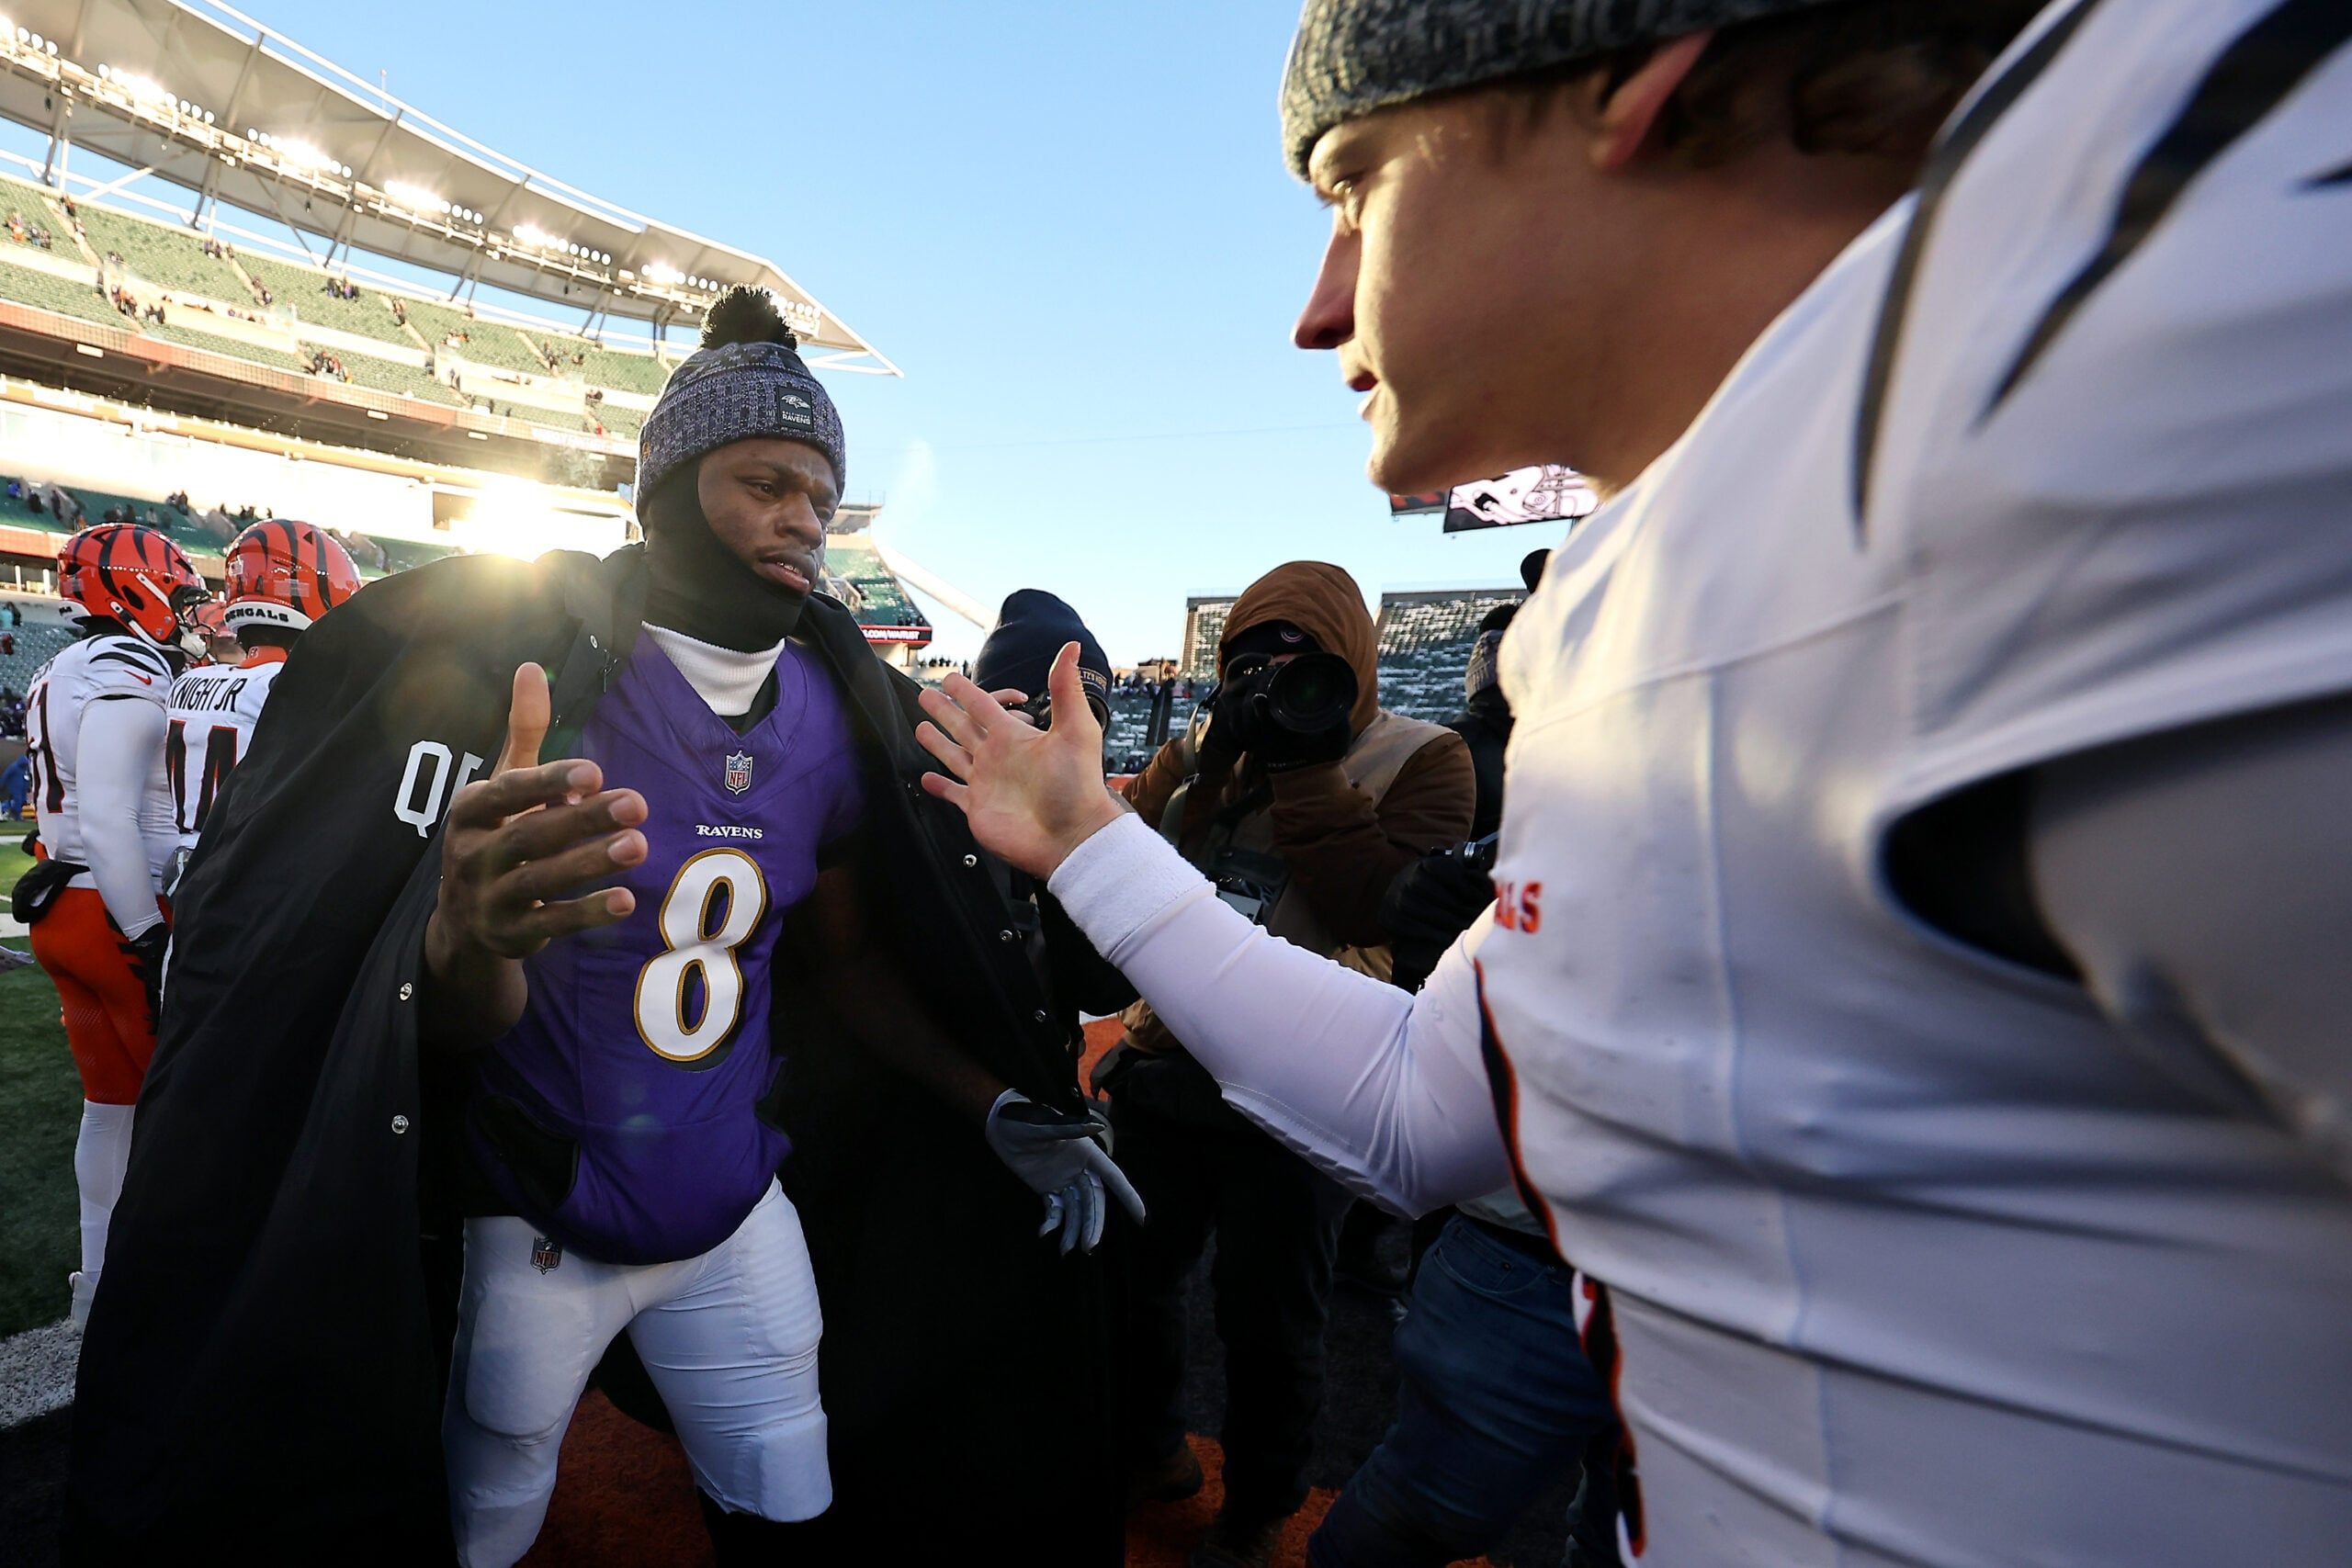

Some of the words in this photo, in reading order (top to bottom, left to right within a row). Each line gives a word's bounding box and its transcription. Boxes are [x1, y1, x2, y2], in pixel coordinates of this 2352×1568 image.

[783, 413, 811, 425] RAVENS
[224, 608, 288, 623] BENGALS
[169, 677, 230, 711] KNIGHT
[214, 677, 248, 713] JR
[728, 770, 749, 788] NFL
[695, 824, 763, 840] RAVENS
[634, 848, 767, 1063] 8
[534, 1250, 560, 1267] NFL
